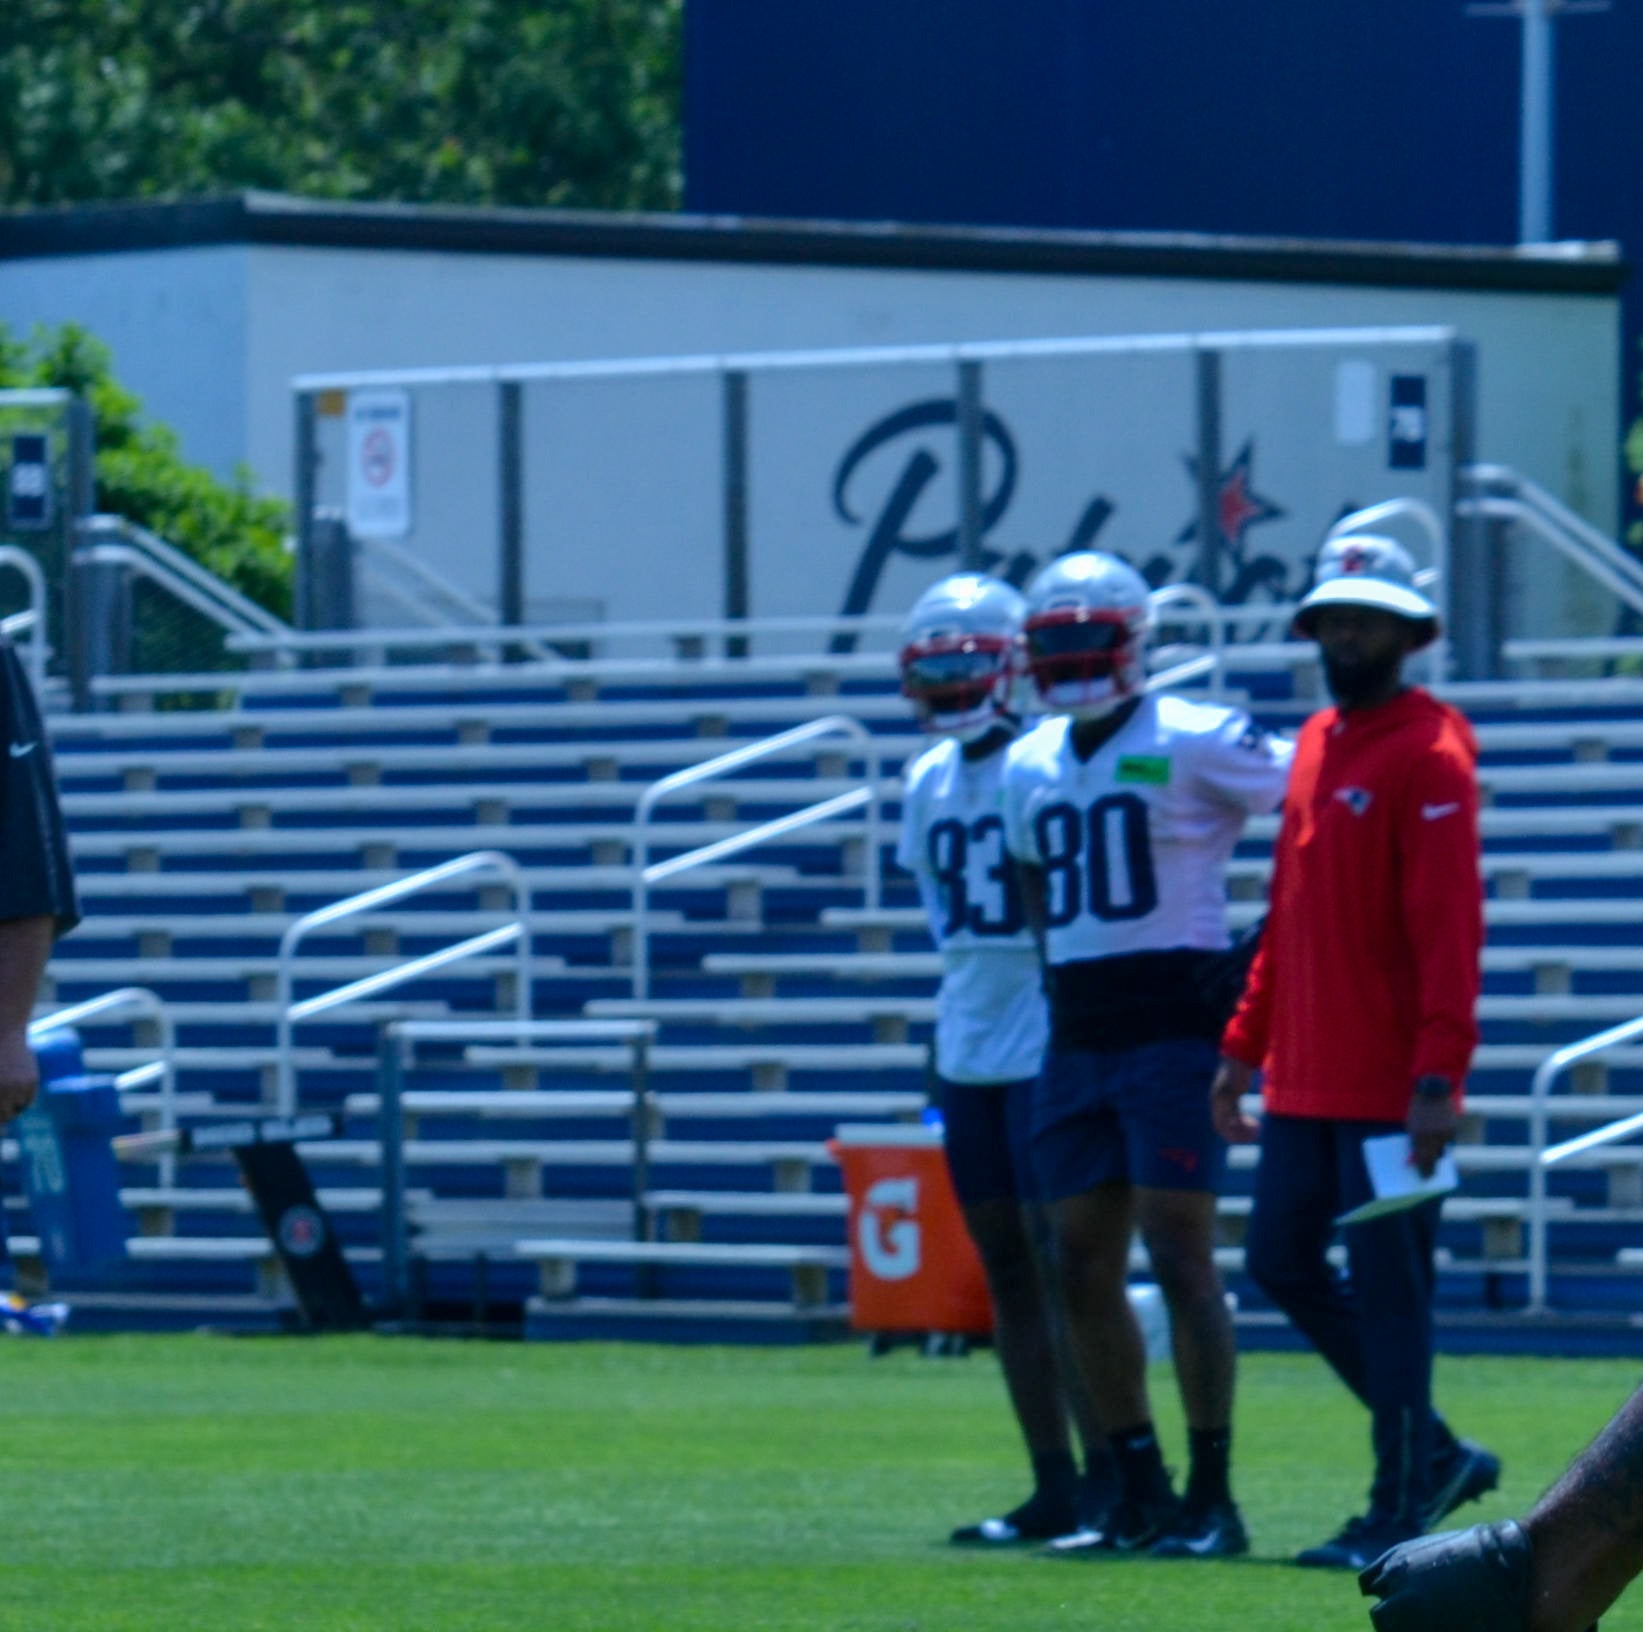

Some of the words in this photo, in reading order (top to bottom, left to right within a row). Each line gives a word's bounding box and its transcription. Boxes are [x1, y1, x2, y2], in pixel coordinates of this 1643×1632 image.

[928, 814, 1024, 936] 83
[1034, 792, 1158, 929] 80
[858, 1176, 921, 1282] G
